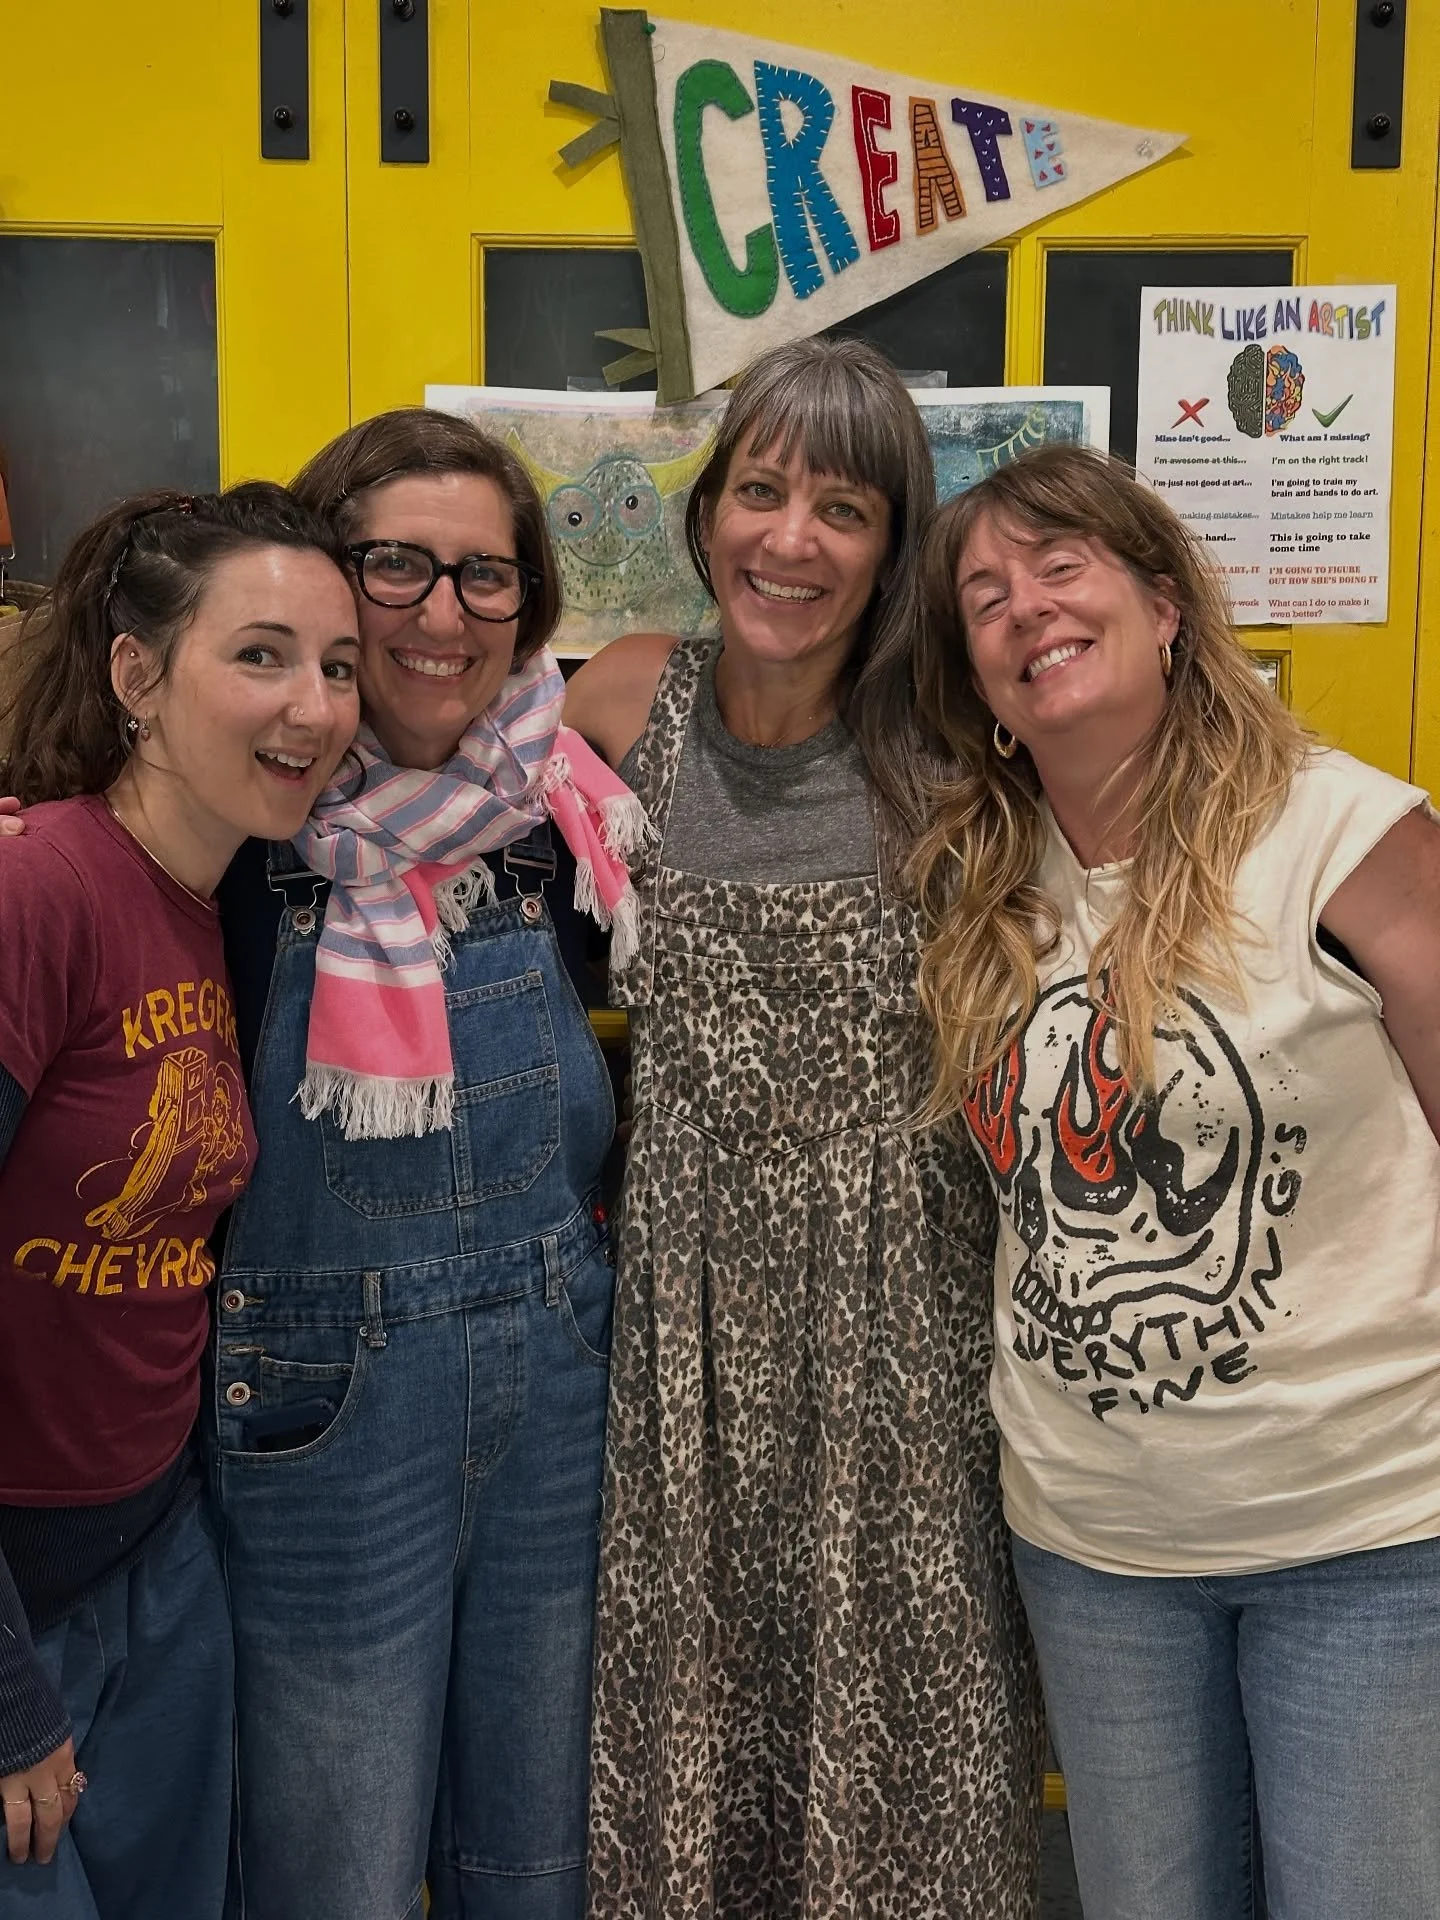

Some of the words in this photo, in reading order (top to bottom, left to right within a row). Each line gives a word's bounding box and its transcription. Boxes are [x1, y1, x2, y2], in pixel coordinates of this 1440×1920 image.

[674, 59, 1067, 319] CREATE
[1153, 298, 1214, 337] THINK
[1221, 304, 1267, 341] LIKE
[1273, 297, 1301, 333] AN
[1308, 299, 1386, 341] ARTIST
[1155, 434, 1177, 442] Mine
[1178, 434, 1199, 442] isn't
[1201, 434, 1231, 443] good...
[1280, 434, 1305, 442] What
[1323, 433, 1328, 441] I
[1329, 433, 1370, 442] missing?
[1154, 456, 1167, 464] I'm
[1223, 455, 1247, 464] this...
[1271, 456, 1286, 464] I'm
[1302, 456, 1316, 464] the
[1319, 455, 1340, 465] right
[1342, 454, 1368, 463] track!
[1153, 479, 1166, 487] I'm
[1168, 479, 1183, 488] just
[1185, 479, 1199, 487] not
[1200, 479, 1220, 488] good
[1232, 479, 1252, 487] art...
[1271, 479, 1285, 487] I'm
[1287, 478, 1310, 488] going
[1323, 478, 1343, 486] train
[1345, 479, 1358, 487] my
[1271, 489, 1293, 497] brain
[1295, 489, 1311, 497] and
[1313, 489, 1339, 497] hands
[1351, 488, 1361, 496] do
[1363, 488, 1379, 496] art.
[1213, 511, 1260, 520] mistakes...
[1270, 512, 1311, 520] Mistakes
[1312, 511, 1332, 520] help
[1349, 510, 1374, 519] learn
[1205, 533, 1237, 541] hard...
[1269, 533, 1292, 542] This
[1294, 533, 1303, 541] is
[1306, 532, 1334, 543] going
[1349, 532, 1371, 540] take
[1269, 545, 1296, 553] some
[1298, 544, 1321, 552] time
[1251, 566, 1260, 574] IT
[1269, 567, 1283, 575] I'M
[1284, 566, 1313, 575] GOING
[1315, 566, 1326, 574] TO
[1328, 565, 1361, 574] FIGURE
[1268, 577, 1287, 585] OUT
[1288, 577, 1309, 585] HOW
[1310, 576, 1337, 585] SHE'S
[1339, 576, 1367, 584] DOING
[1368, 575, 1378, 584] IT
[1238, 598, 1260, 607] work
[1268, 599, 1291, 608] What
[1309, 599, 1314, 607] I
[1314, 599, 1324, 607] do
[1338, 598, 1362, 607] make
[1363, 598, 1370, 606] it
[1292, 609, 1323, 618] better?
[1088, 1342, 1257, 1423] FINE
